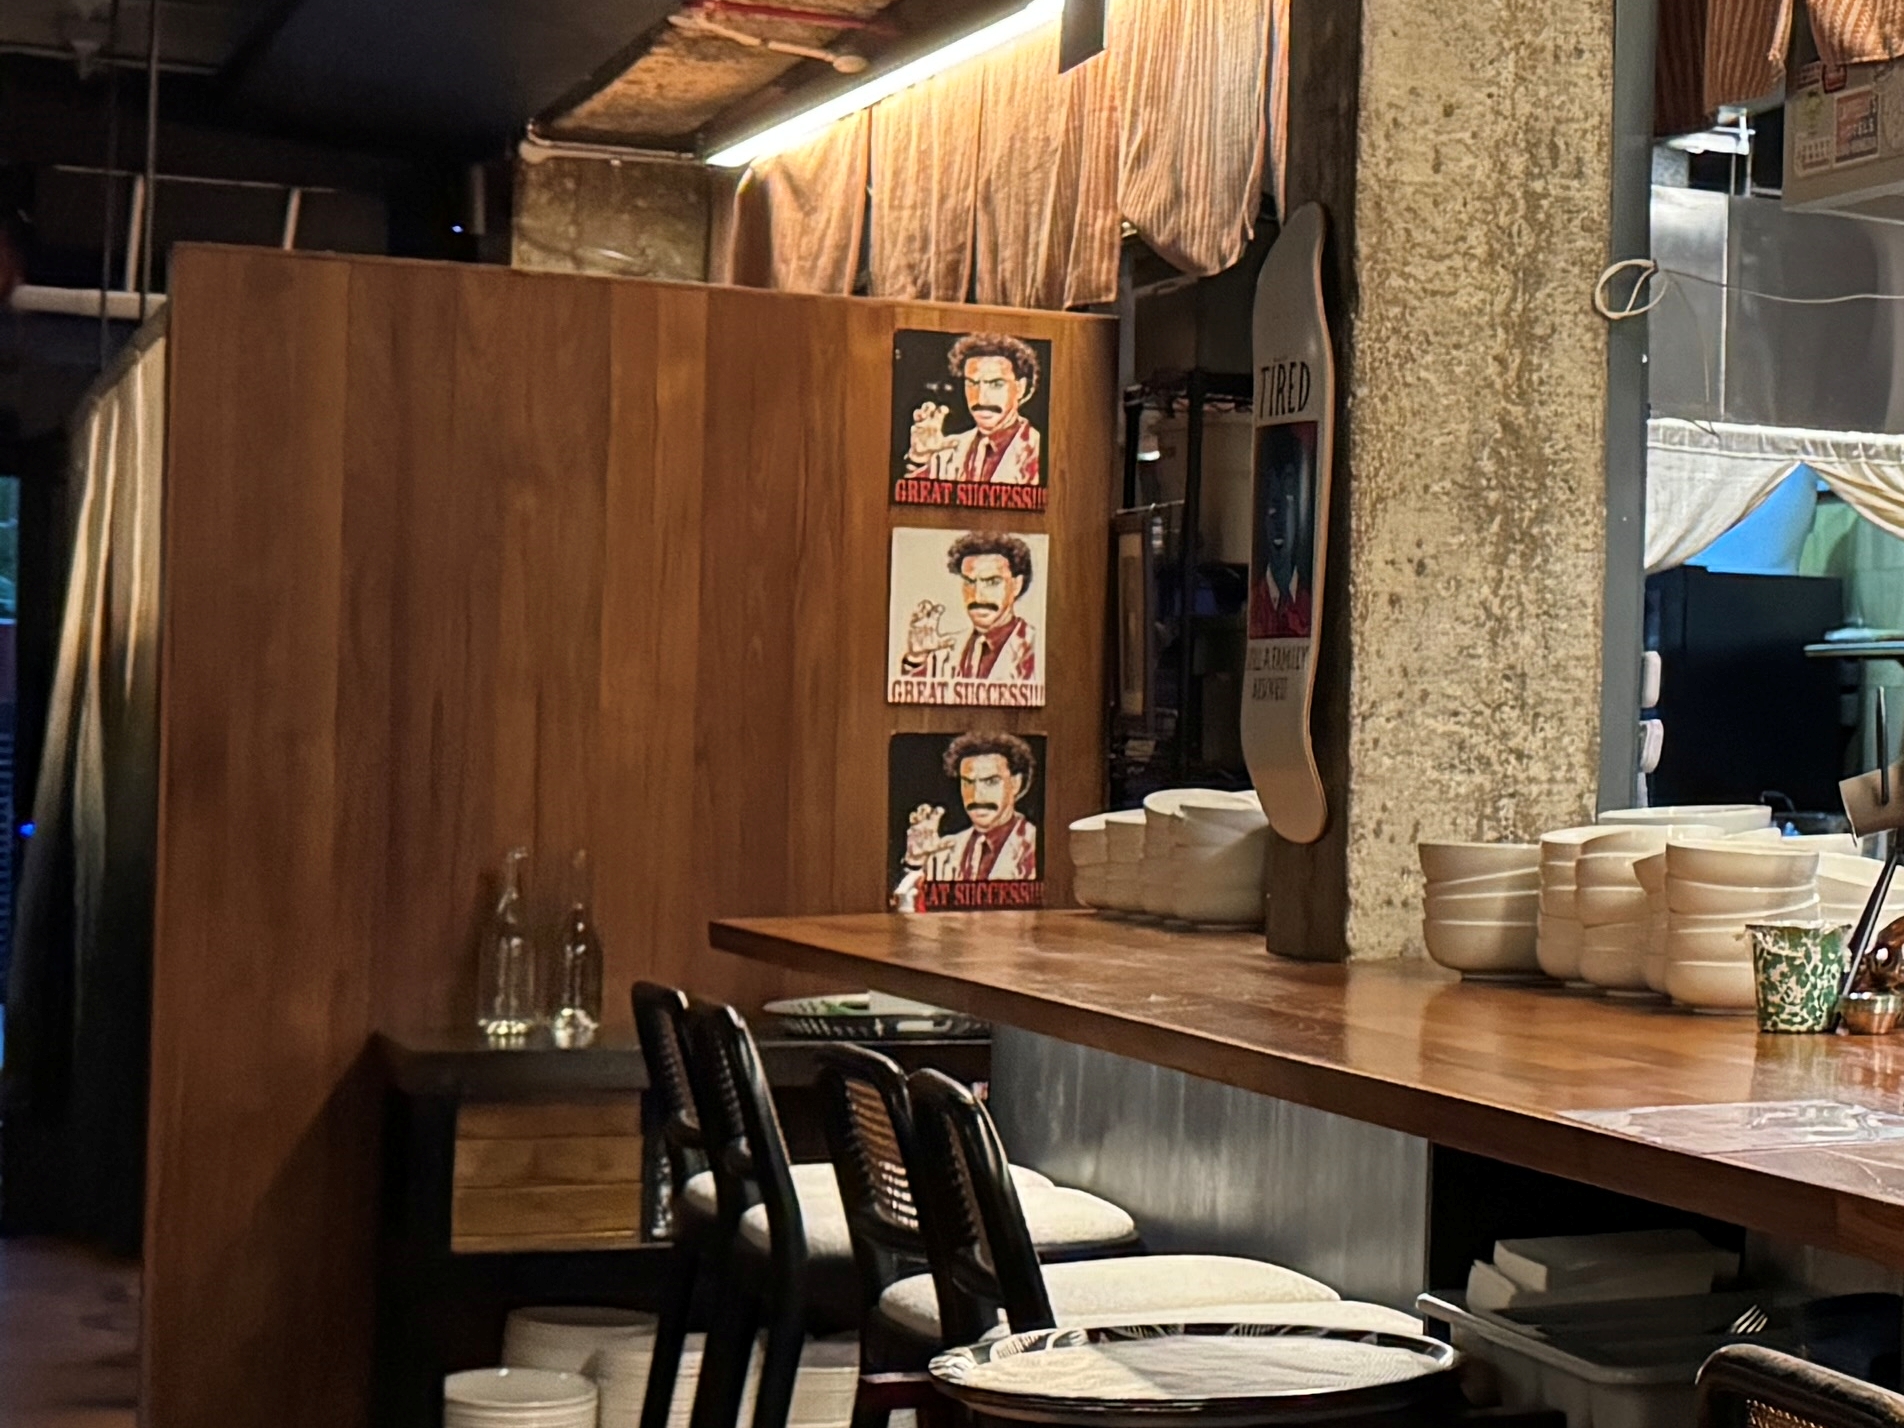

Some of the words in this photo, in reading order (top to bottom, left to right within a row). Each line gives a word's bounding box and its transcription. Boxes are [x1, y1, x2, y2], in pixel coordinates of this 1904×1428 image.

[1260, 361, 1311, 419] TIRED
[895, 478, 953, 506] GREAT
[891, 680, 948, 704] GREAT
